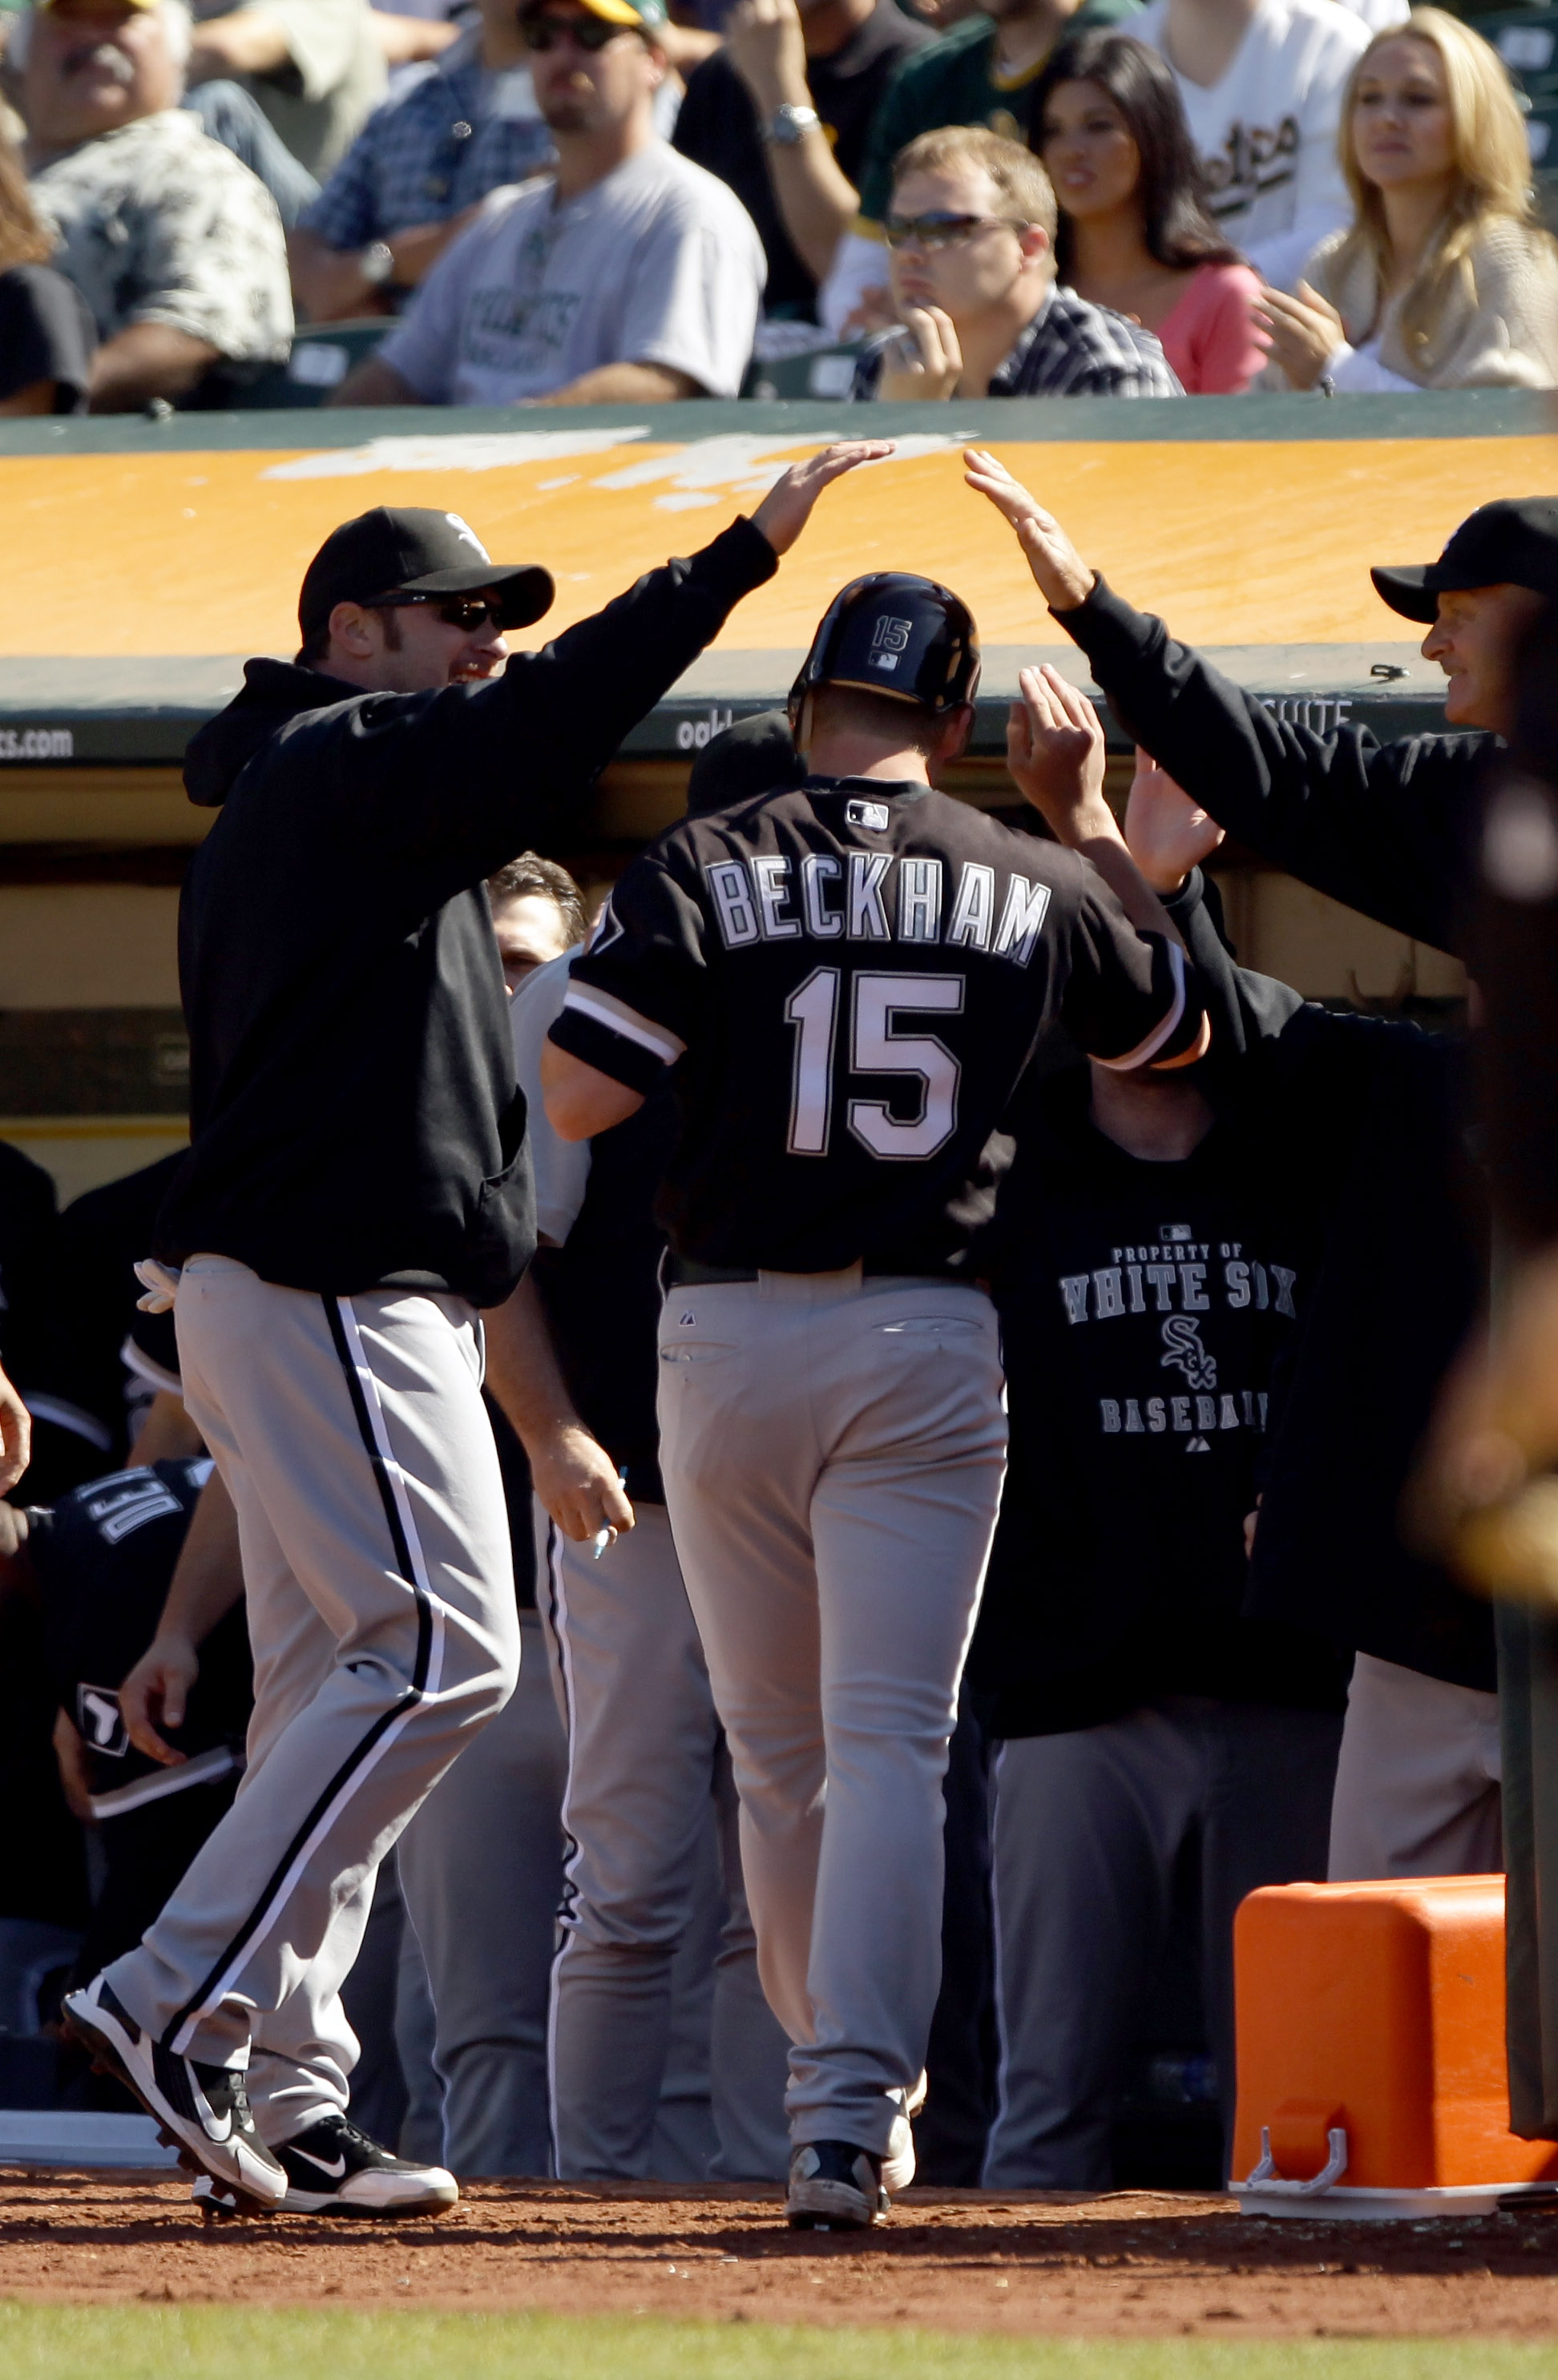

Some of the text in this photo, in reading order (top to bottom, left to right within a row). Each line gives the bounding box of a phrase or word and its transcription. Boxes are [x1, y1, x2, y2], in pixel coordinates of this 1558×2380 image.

[872, 615, 913, 651] 15
[704, 850, 1052, 969] BECKHAM
[783, 965, 967, 1161] 15
[1111, 1242, 1242, 1264] PROPERTY OF
